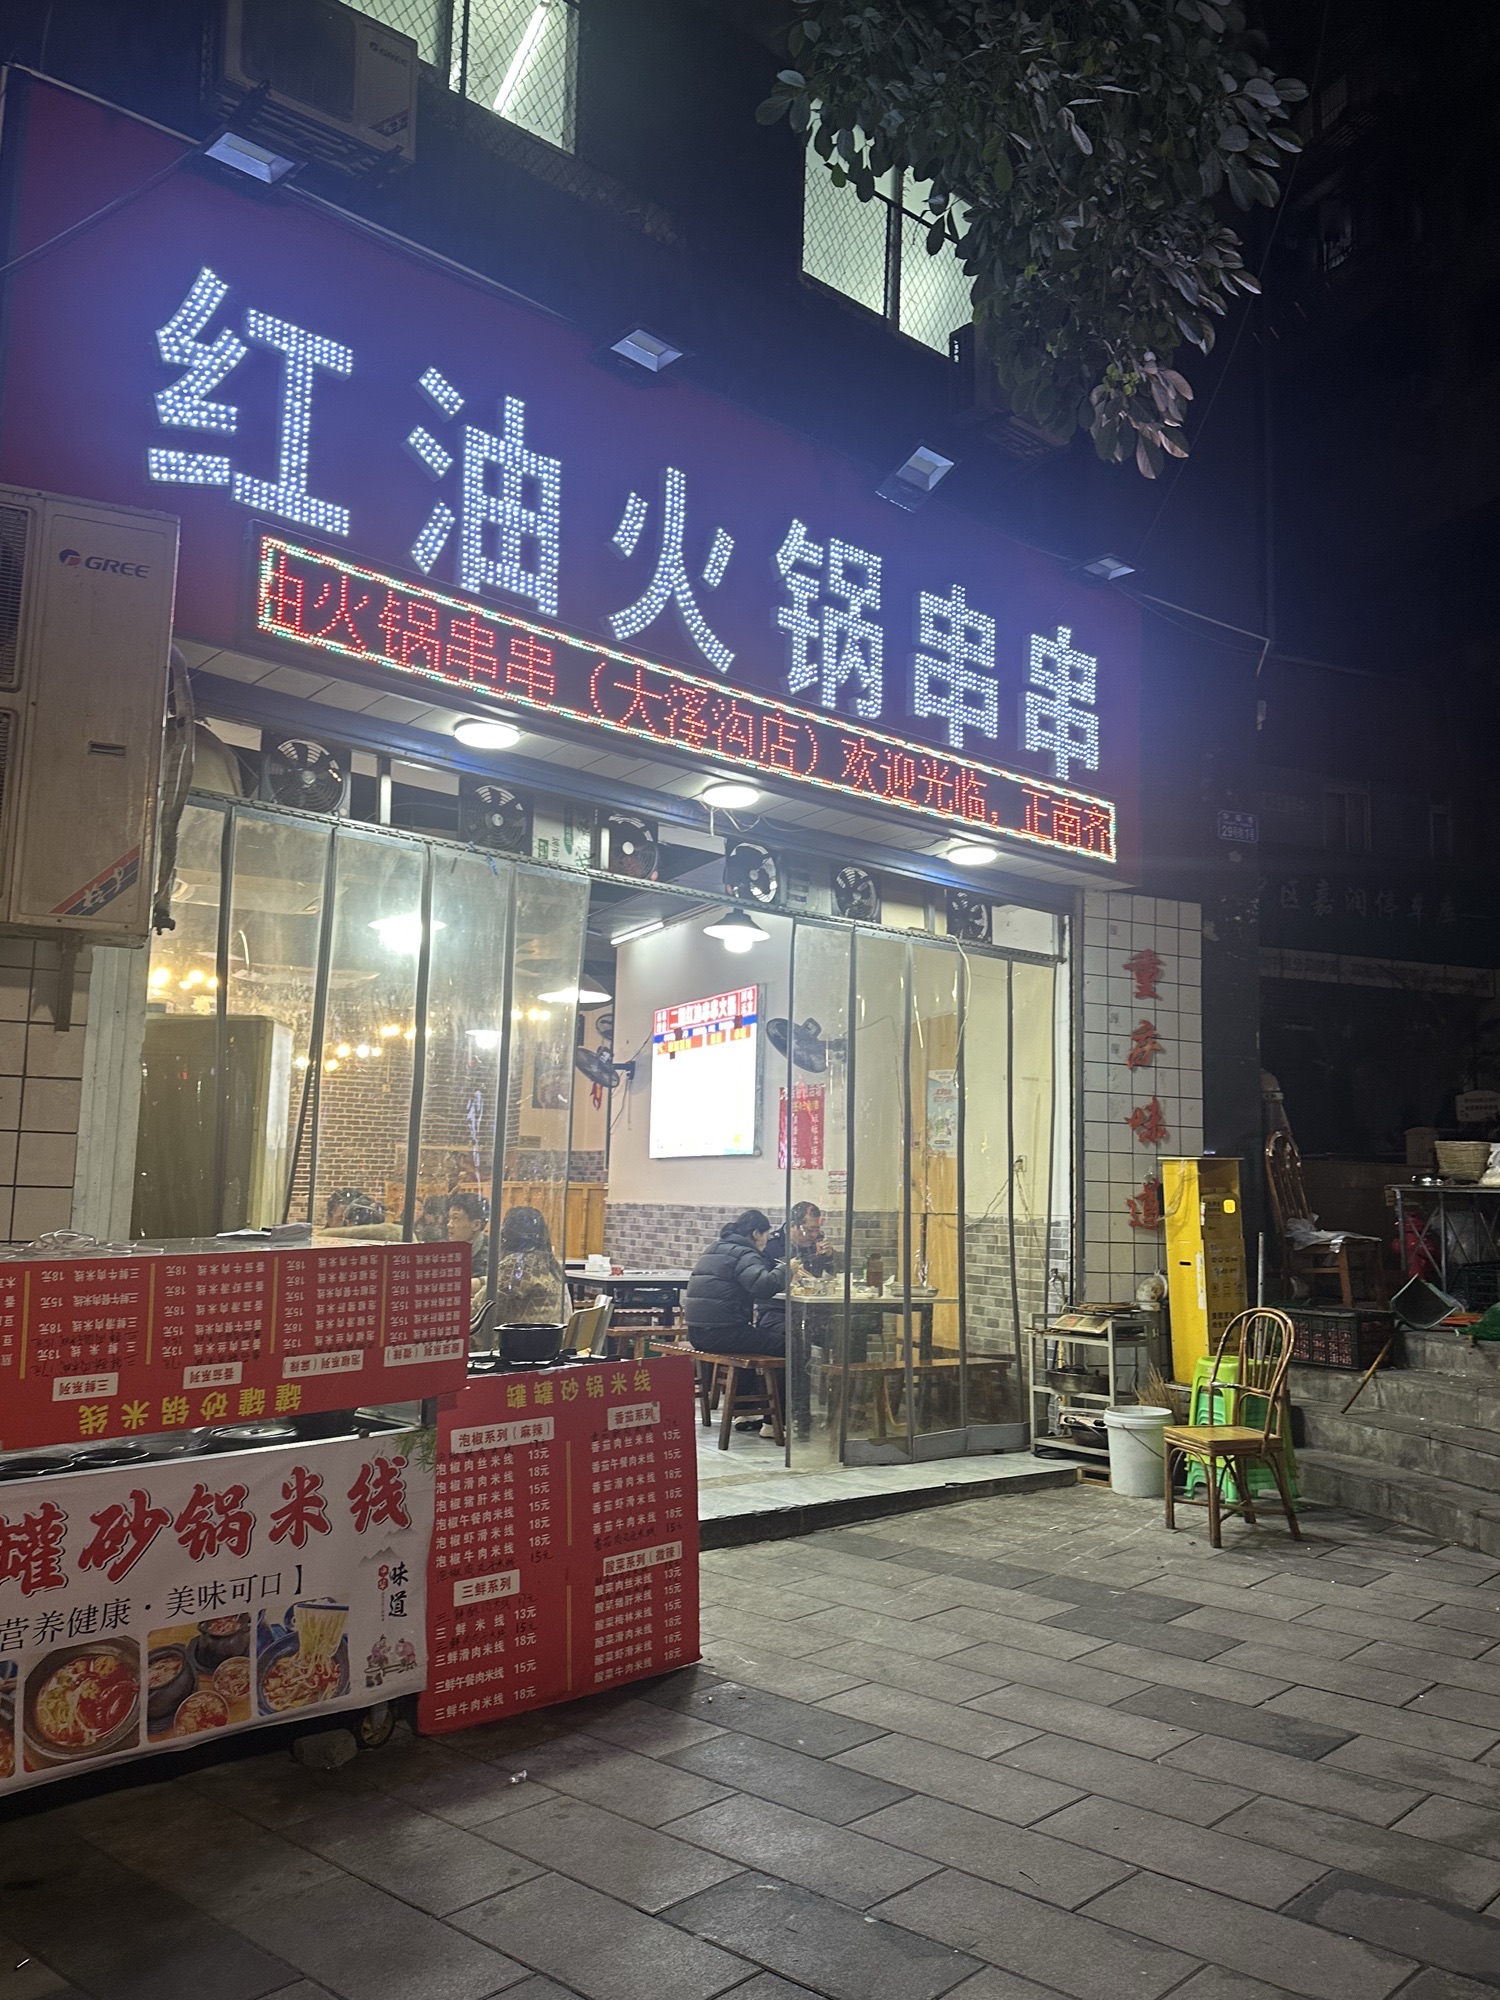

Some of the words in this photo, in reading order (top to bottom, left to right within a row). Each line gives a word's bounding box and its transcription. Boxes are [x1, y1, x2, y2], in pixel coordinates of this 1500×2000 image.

[148, 265, 1100, 780] 红油火锅串串
[85, 556, 151, 578] GREE
[1122, 948, 1165, 1230] 重庆味道
[166, 1266, 186, 1276] 18元
[287, 1261, 305, 1271] 18元
[42, 1271, 64, 1282] 18元
[74, 1268, 140, 1282] 三鲜牛肉米线
[286, 1276, 305, 1286] 18元
[165, 1286, 185, 1296] 18元
[285, 1292, 304, 1302] 15元
[41, 1297, 63, 1308] 15元
[164, 1306, 184, 1317] 18元
[285, 1307, 303, 1318] 15元
[39, 1323, 62, 1334] 18元
[72, 1317, 137, 1332] 三鲜滑肉米线
[163, 1326, 184, 1337] 15元
[284, 1323, 302, 1333] 18元
[71, 1342, 136, 1357] 三鲜米线
[162, 1346, 182, 1357] 13元
[283, 1339, 301, 1349] 13元
[38, 1350, 60, 1361] 13元
[190, 1367, 234, 1384] 番茄系列
[59, 1380, 108, 1395] 三鲜系列
[506, 1369, 652, 1408] 罐罐砂锅米线
[79, 1383, 302, 1434] 罐罐砂锅米线
[615, 1408, 654, 1425] 番茄系列
[459, 1422, 550, 1447] 泡椒系列（麻辣）
[591, 1433, 654, 1453] 番茄肉丝米线
[663, 1429, 681, 1440] 13元
[436, 1453, 514, 1476] 泡椒肉丝米线
[528, 1448, 550, 1460] 13元
[592, 1452, 655, 1474] 番茄午餐肉米线
[664, 1449, 682, 1460] 15元
[436, 1471, 514, 1494] 泡椒滑肉米线
[528, 1465, 550, 1477] 18元
[592, 1472, 656, 1494] 番茄滑肉米线
[665, 1468, 682, 1479] 18元
[436, 1489, 514, 1512] 泡椒猪肝米线
[529, 1482, 550, 1494] 15元
[592, 1492, 656, 1514] 番茄虾滑米线
[665, 1487, 683, 1499] 18元
[436, 1506, 514, 1531] 泡椒午餐肉米线
[529, 1500, 550, 1512] 15元
[593, 1512, 656, 1535] 番茄牛肉米线
[665, 1507, 683, 1519] 18元
[436, 1524, 514, 1549] 泡椒虾滑米线
[529, 1517, 550, 1529] 18元
[436, 1542, 514, 1568] 泡椒牛肉米线
[529, 1534, 550, 1547] 18元
[664, 1567, 681, 1578] 13元
[388, 1561, 409, 1617] 味道
[462, 1577, 511, 1598] 三鲜系列
[664, 1583, 681, 1594] 15元
[665, 1599, 682, 1611] 15元
[436, 1614, 505, 1640] 三鲜米线
[515, 1606, 537, 1620] 13元
[665, 1616, 682, 1627] 18元
[665, 1632, 681, 1644] 18元
[435, 1640, 505, 1666] 三鲜滑肉米线
[515, 1633, 537, 1646] 18元
[664, 1648, 681, 1660] 18元
[434, 1667, 504, 1694] 三鲜午餐肉米线
[514, 1660, 537, 1673] 15元
[434, 1693, 504, 1721] 三鲜牛肉米线
[514, 1686, 536, 1700] 18元
